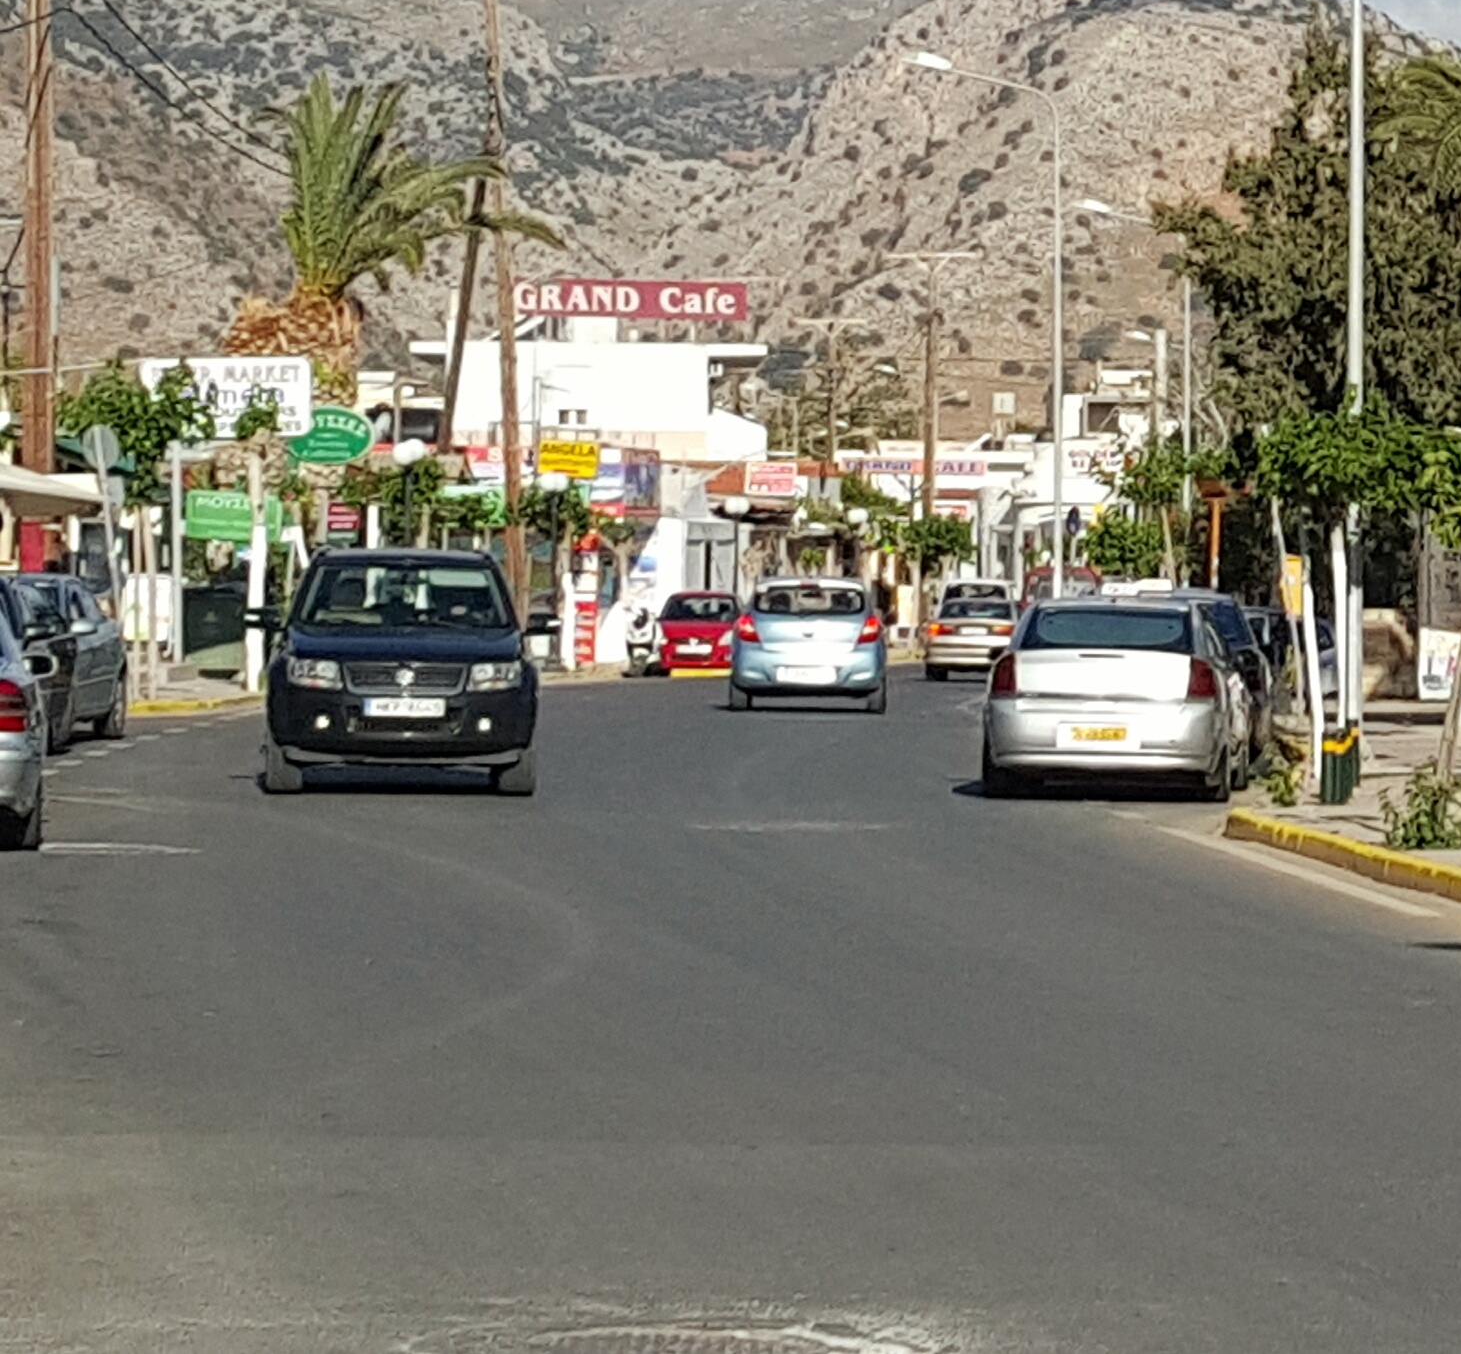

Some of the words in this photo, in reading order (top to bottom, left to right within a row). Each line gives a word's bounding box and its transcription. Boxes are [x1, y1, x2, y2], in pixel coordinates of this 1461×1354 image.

[513, 282, 640, 312] GRAND
[659, 286, 737, 314] Cafe
[222, 365, 301, 384] MARKET
